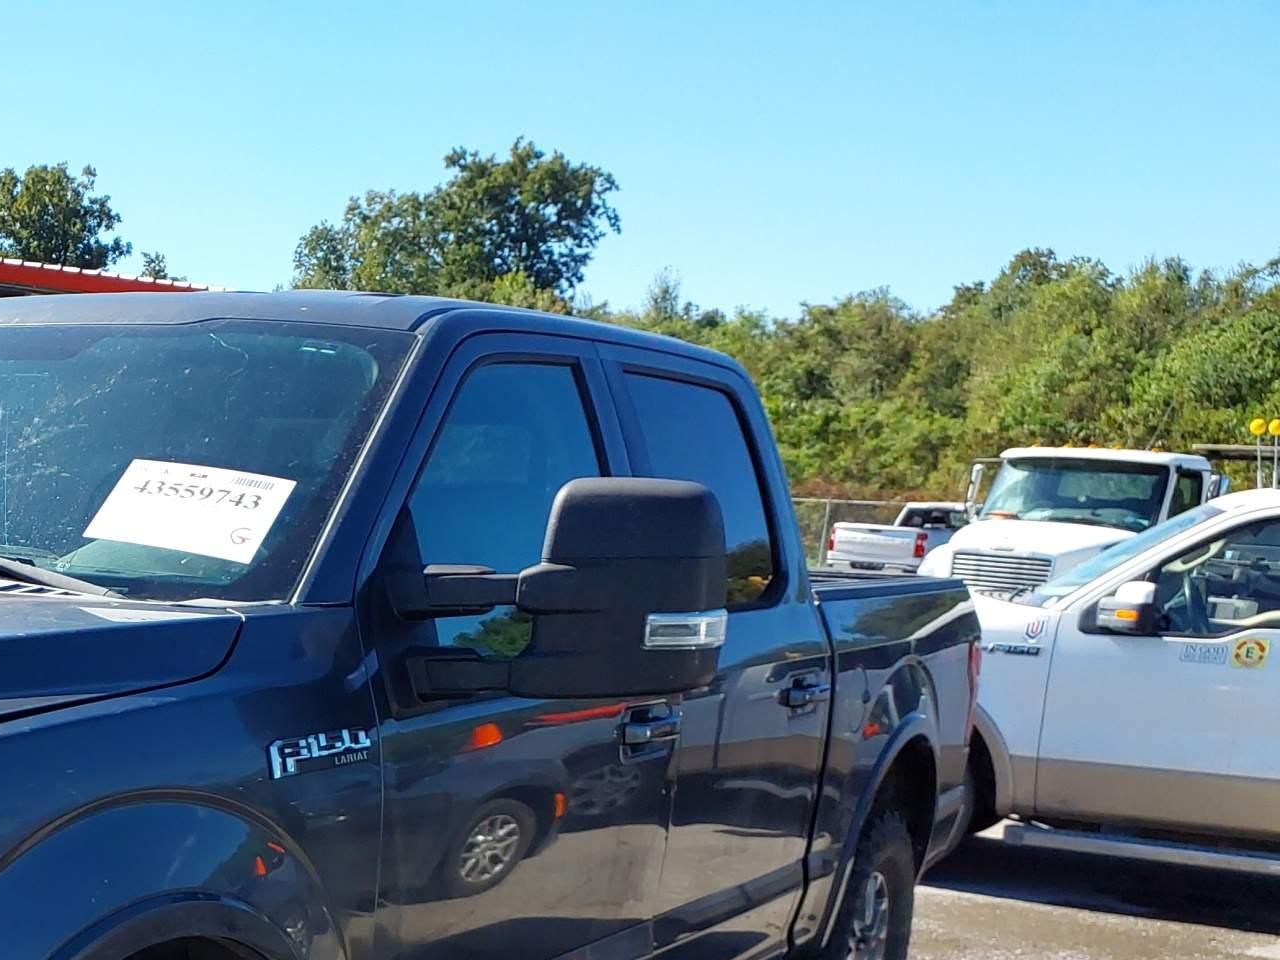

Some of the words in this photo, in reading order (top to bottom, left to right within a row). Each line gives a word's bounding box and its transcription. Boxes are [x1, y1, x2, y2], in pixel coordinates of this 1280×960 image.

[133, 479, 263, 511] 43559743
[1245, 647, 1255, 659] E
[334, 750, 369, 766] LARIAT
